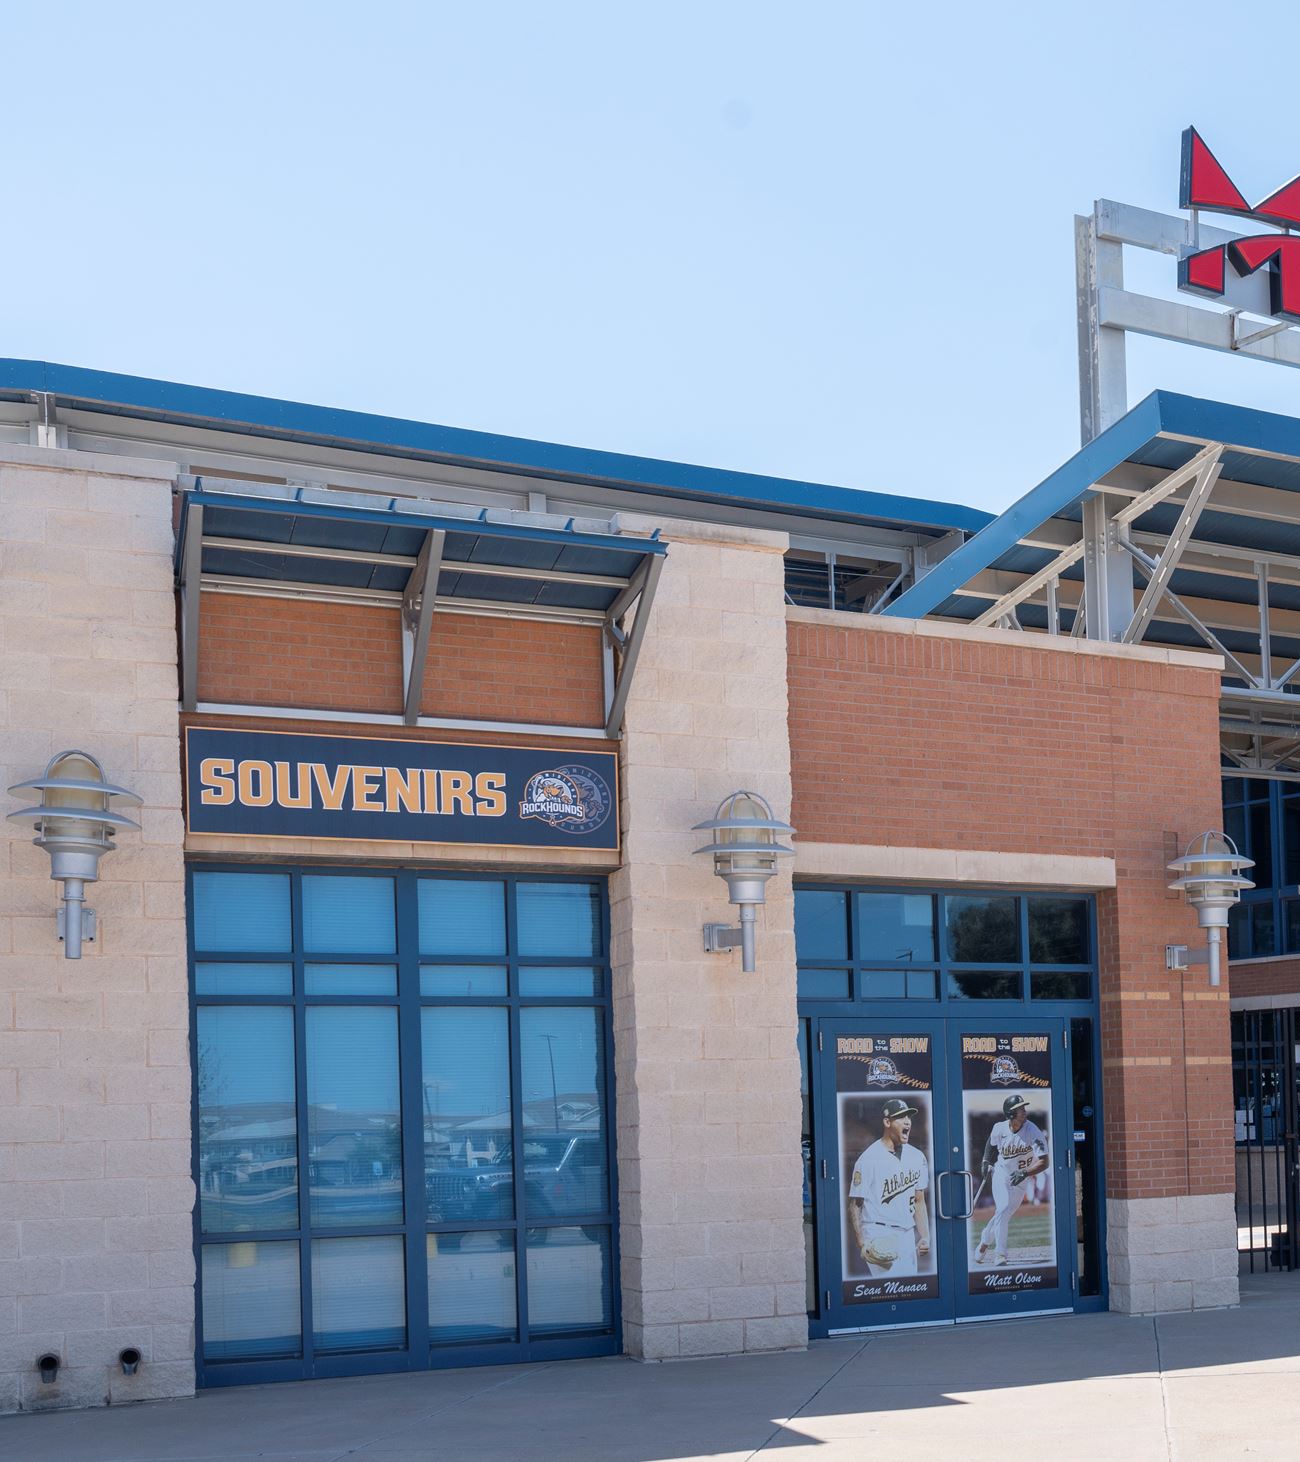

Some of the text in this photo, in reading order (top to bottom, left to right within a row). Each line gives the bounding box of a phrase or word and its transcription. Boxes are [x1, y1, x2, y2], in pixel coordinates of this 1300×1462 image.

[200, 758, 507, 817] SOUVENIRS
[522, 802, 583, 817] ROCKHOUNDS
[837, 1038, 873, 1053] ROAD
[890, 1038, 928, 1053] SHOW
[963, 1037, 997, 1052] ROAD
[1012, 1037, 1048, 1052] SHOW
[984, 1272, 1042, 1286] Matt Olson
[854, 1281, 928, 1297] Sean Manaea
